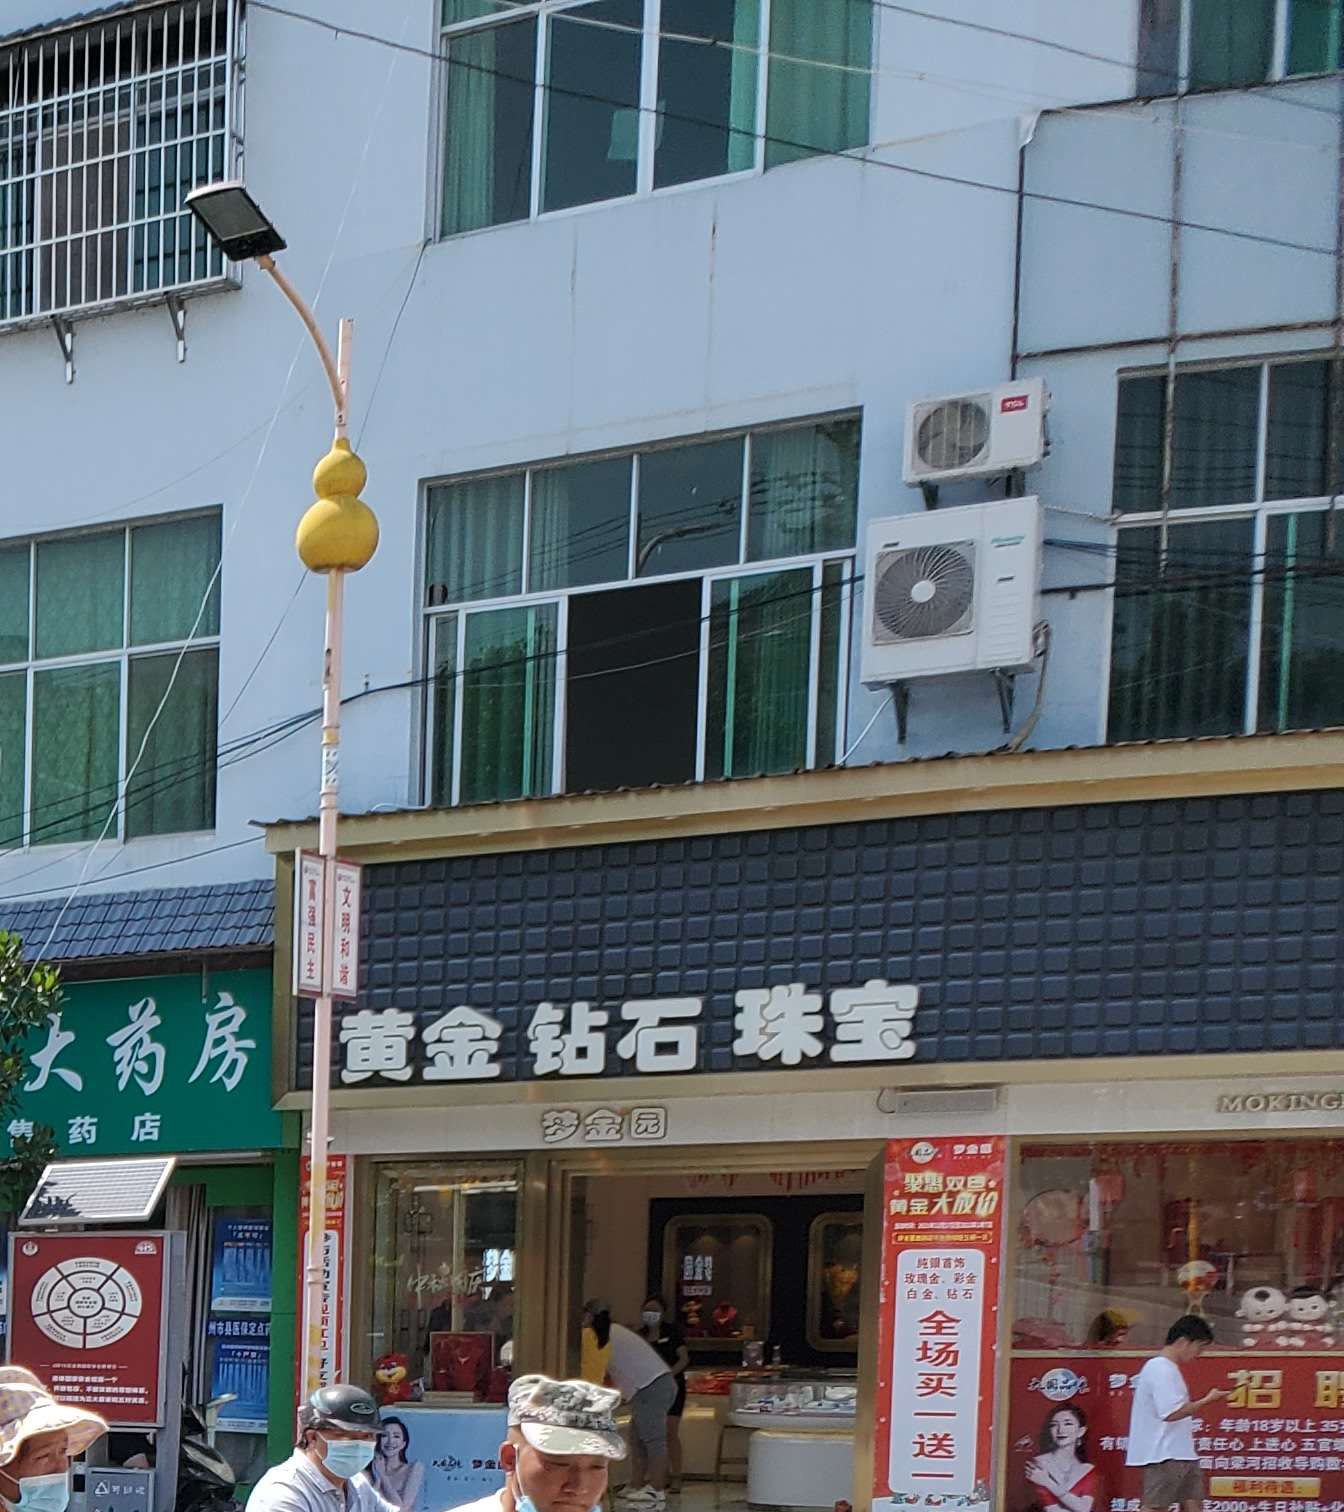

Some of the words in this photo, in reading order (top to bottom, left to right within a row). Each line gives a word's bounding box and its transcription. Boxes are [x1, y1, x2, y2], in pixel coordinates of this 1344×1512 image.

[23, 992, 256, 1096] 大药房
[340, 1006, 500, 1084] 黄金
[528, 997, 703, 1077] 钻石
[733, 979, 920, 1066] 珠宝
[542, 1107, 667, 1143] 梦金园
[1216, 1093, 1344, 1113] MOKING
[911, 1310, 962, 1478] 全场买一送一
